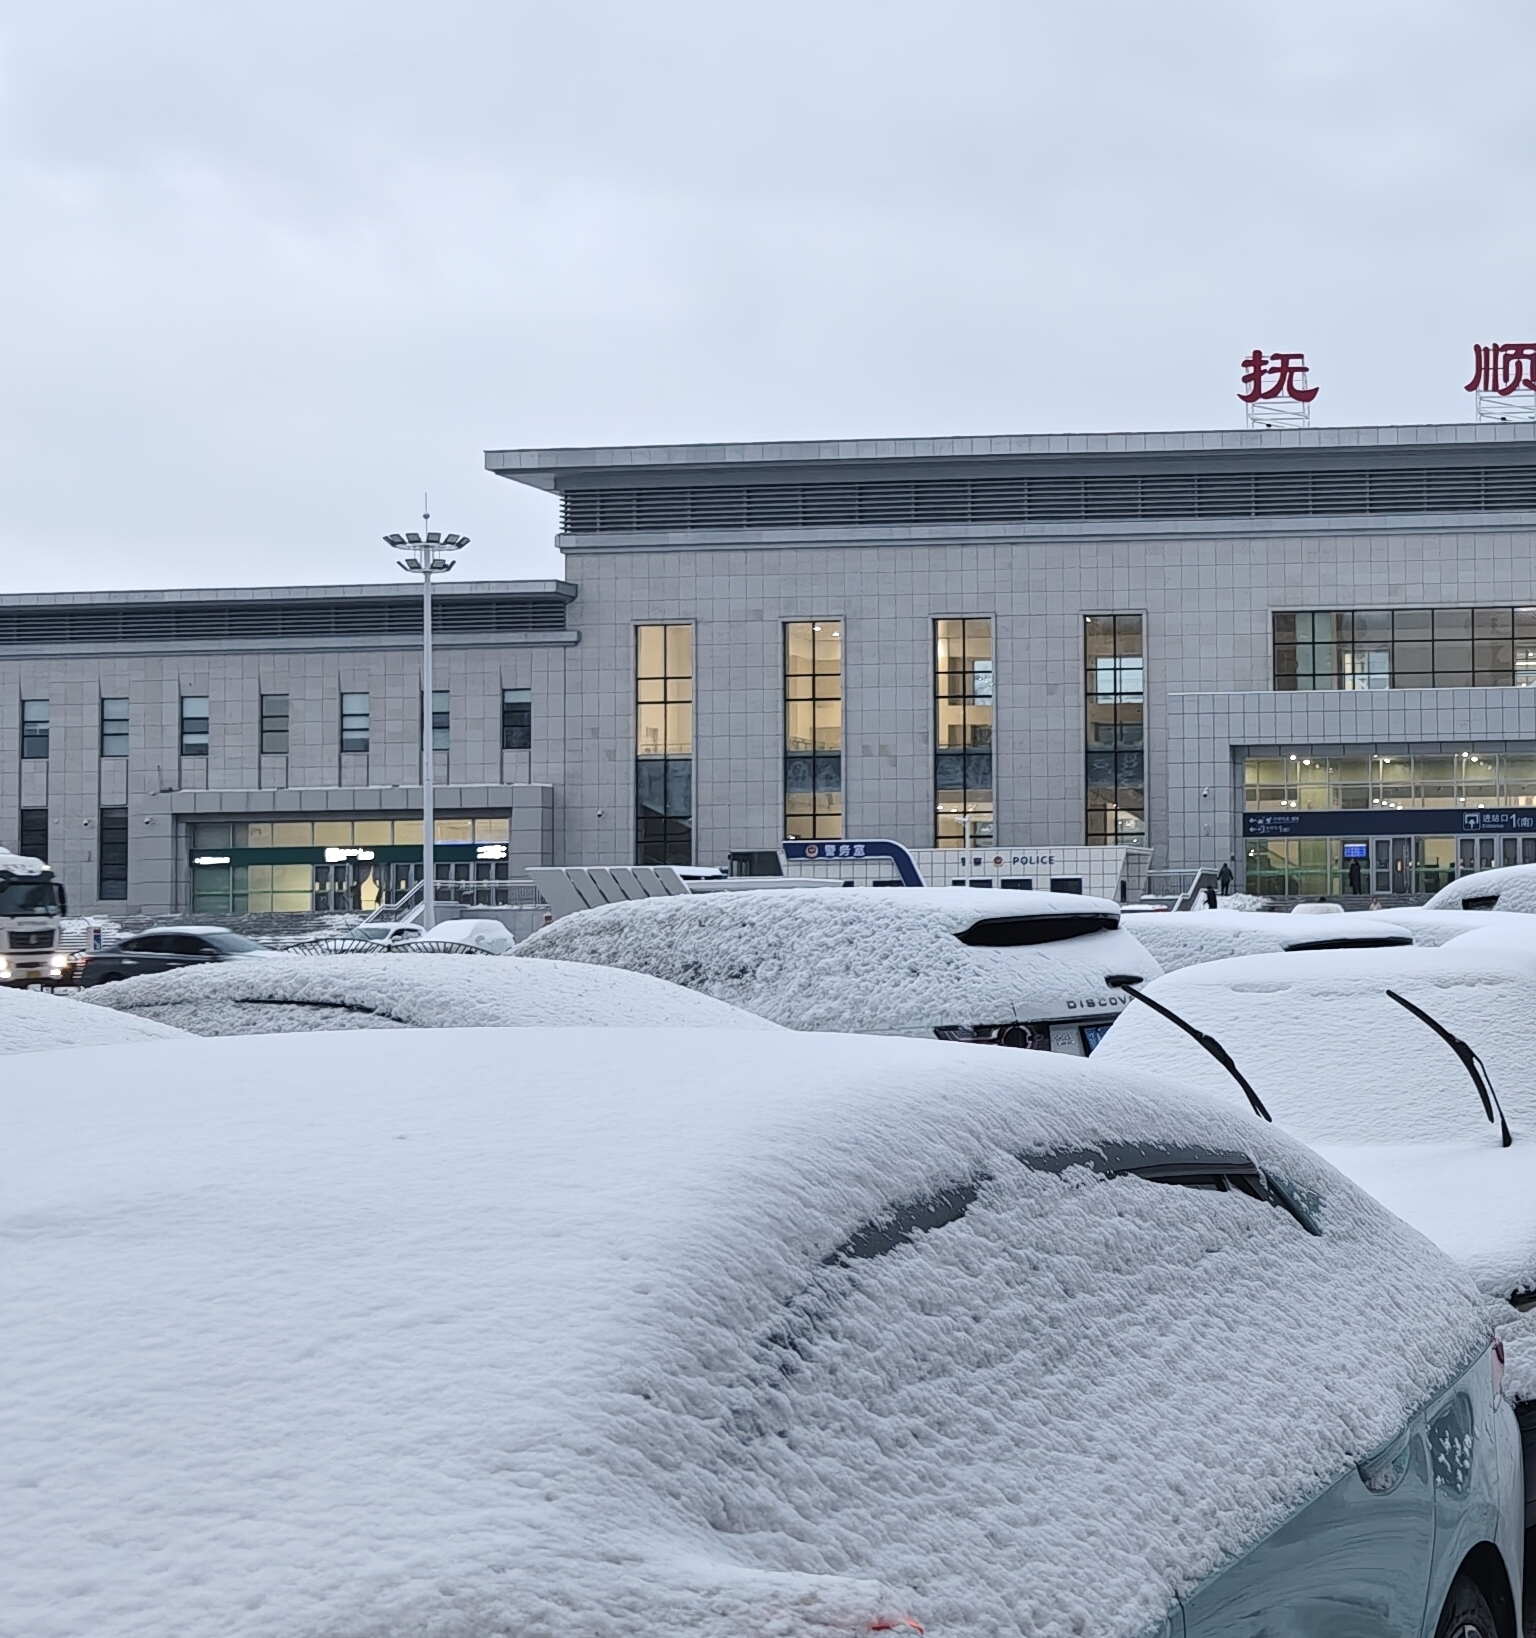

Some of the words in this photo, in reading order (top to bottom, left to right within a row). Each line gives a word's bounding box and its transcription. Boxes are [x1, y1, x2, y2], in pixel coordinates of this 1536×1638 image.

[824, 844, 866, 857] 警务室
[1012, 855, 1055, 865] POLICE
